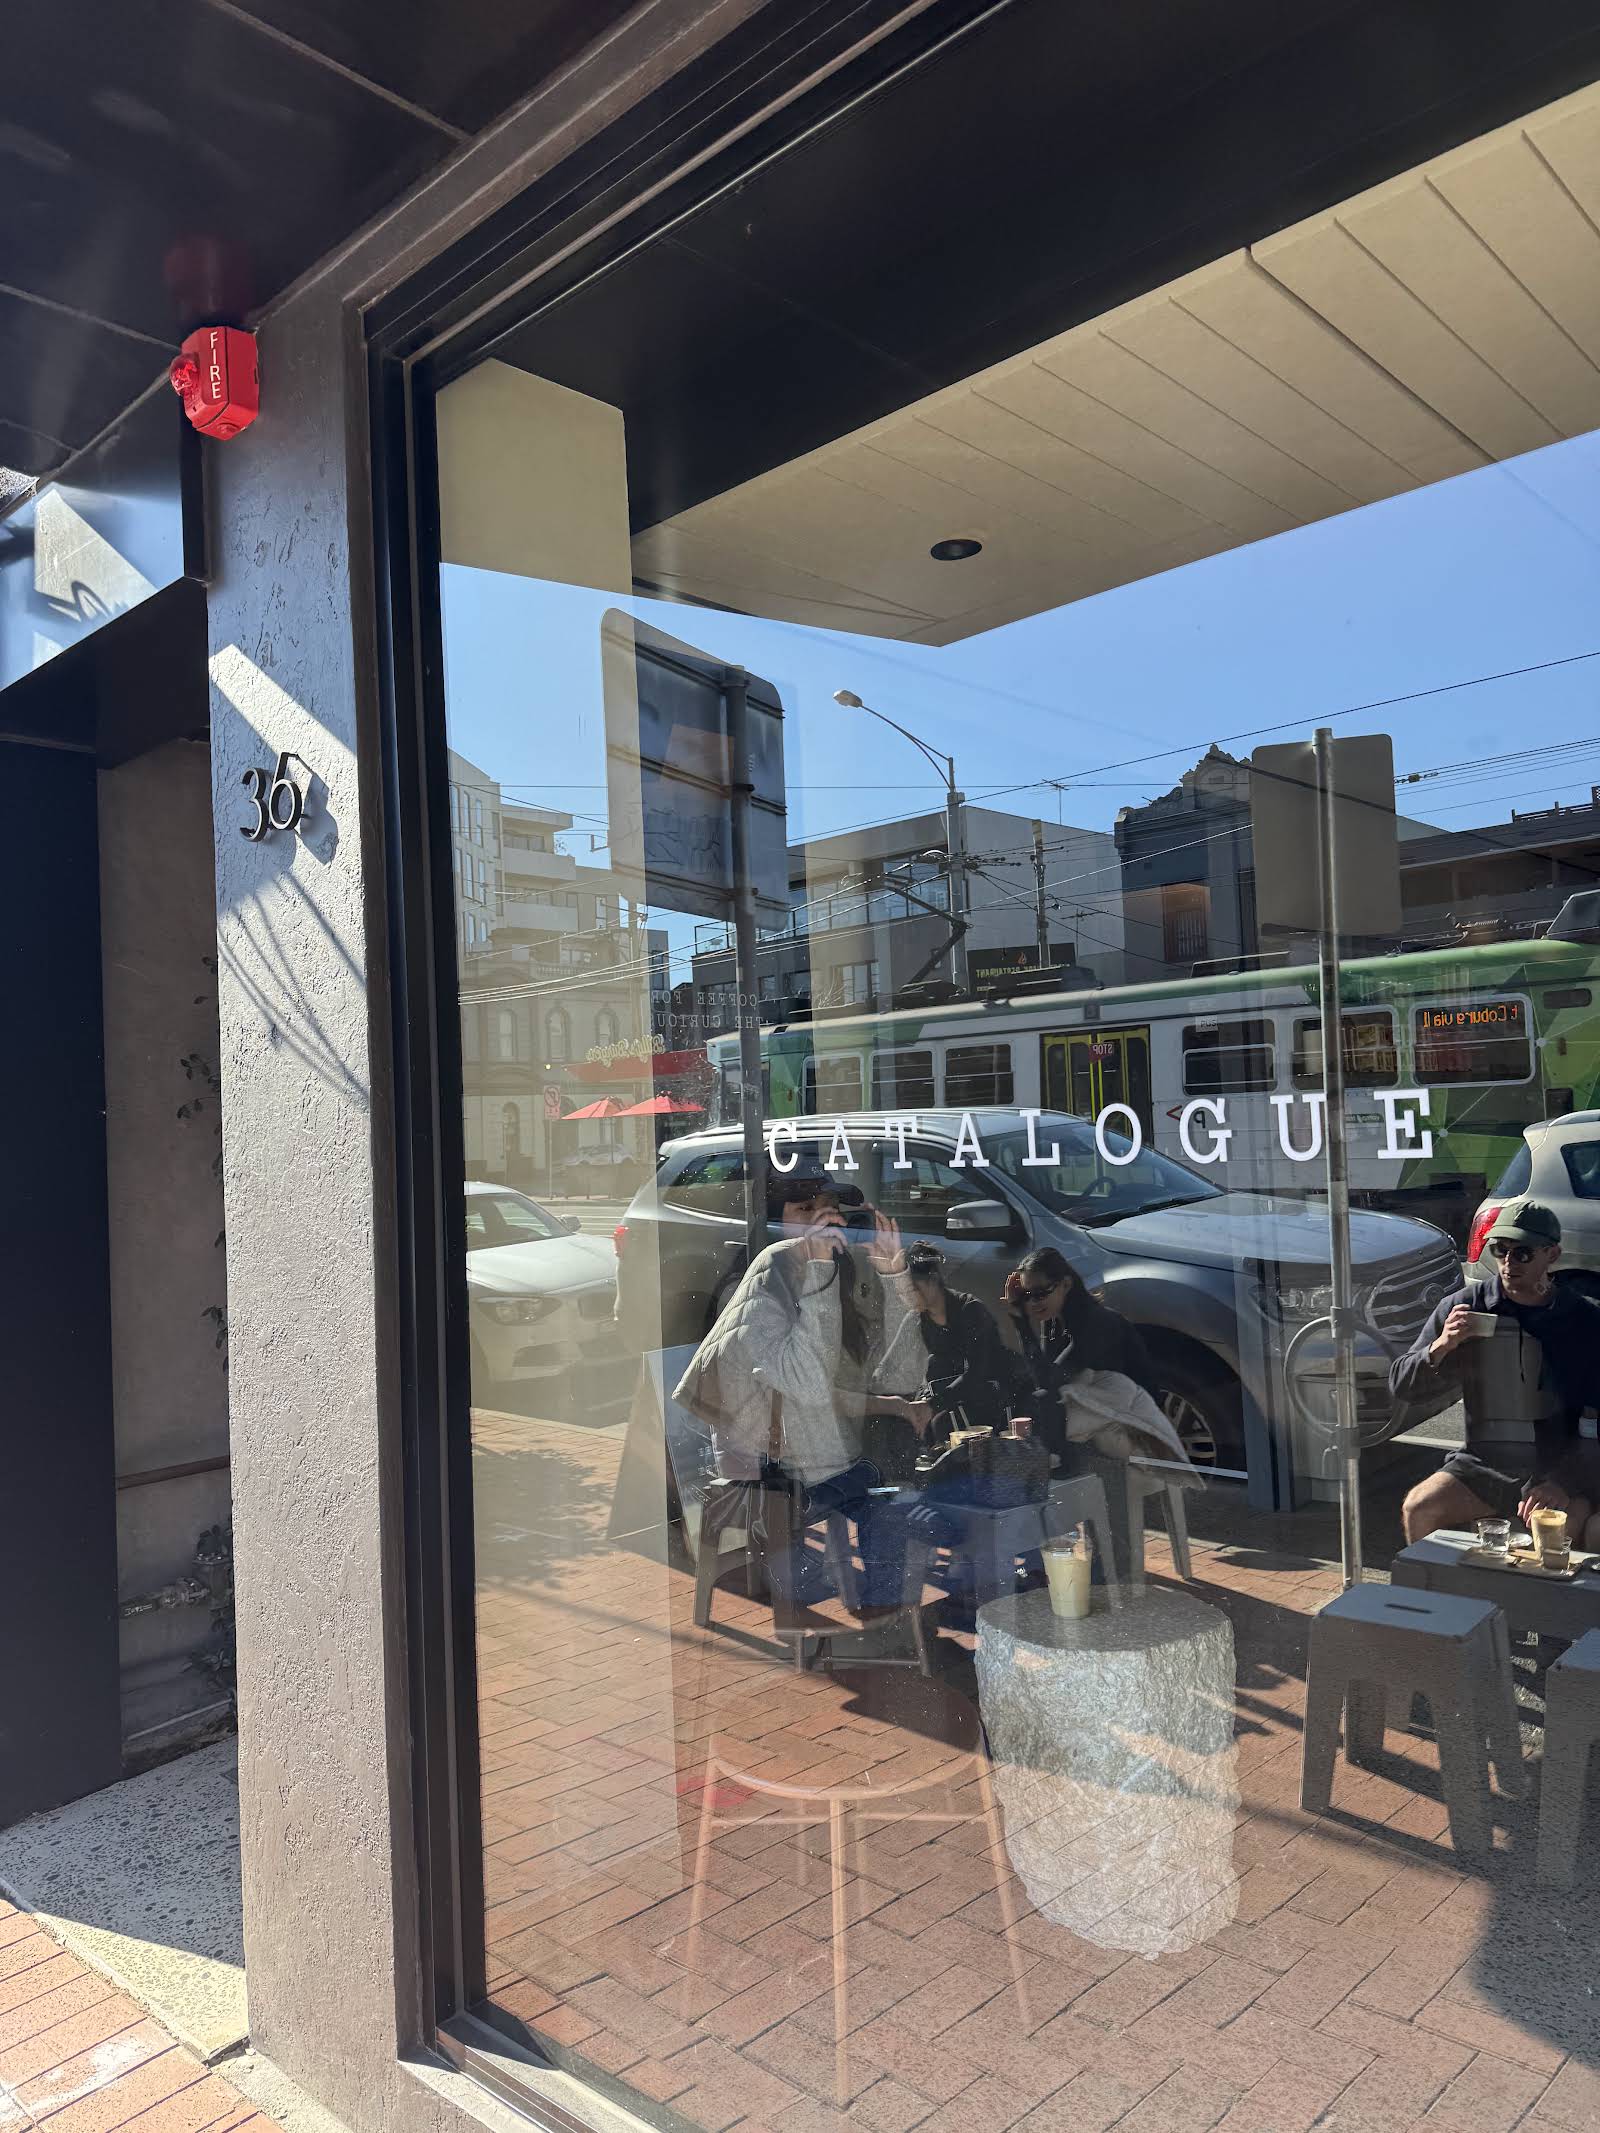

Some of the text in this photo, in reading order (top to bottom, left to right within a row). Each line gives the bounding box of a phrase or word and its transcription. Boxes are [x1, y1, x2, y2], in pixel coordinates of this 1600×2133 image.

[209, 331, 222, 399] FIRE
[240, 751, 303, 843] 36
[767, 1087, 1434, 1173] CATALOGUE
